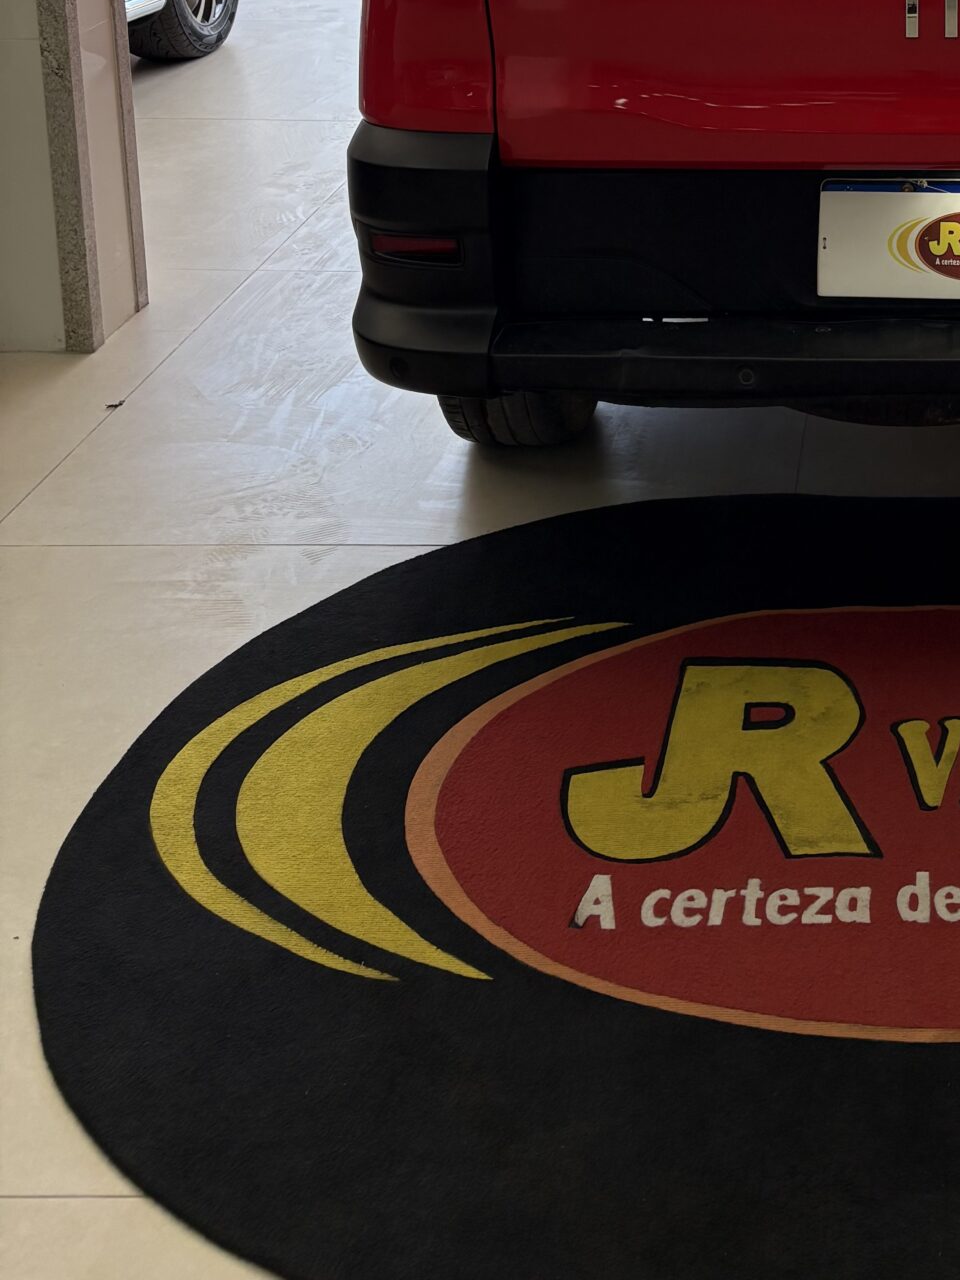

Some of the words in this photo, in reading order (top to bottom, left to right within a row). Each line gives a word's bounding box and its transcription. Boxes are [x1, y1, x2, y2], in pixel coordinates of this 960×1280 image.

[560, 656, 883, 865] JR
[568, 874, 616, 929] A
[640, 878, 871, 927] certeza
